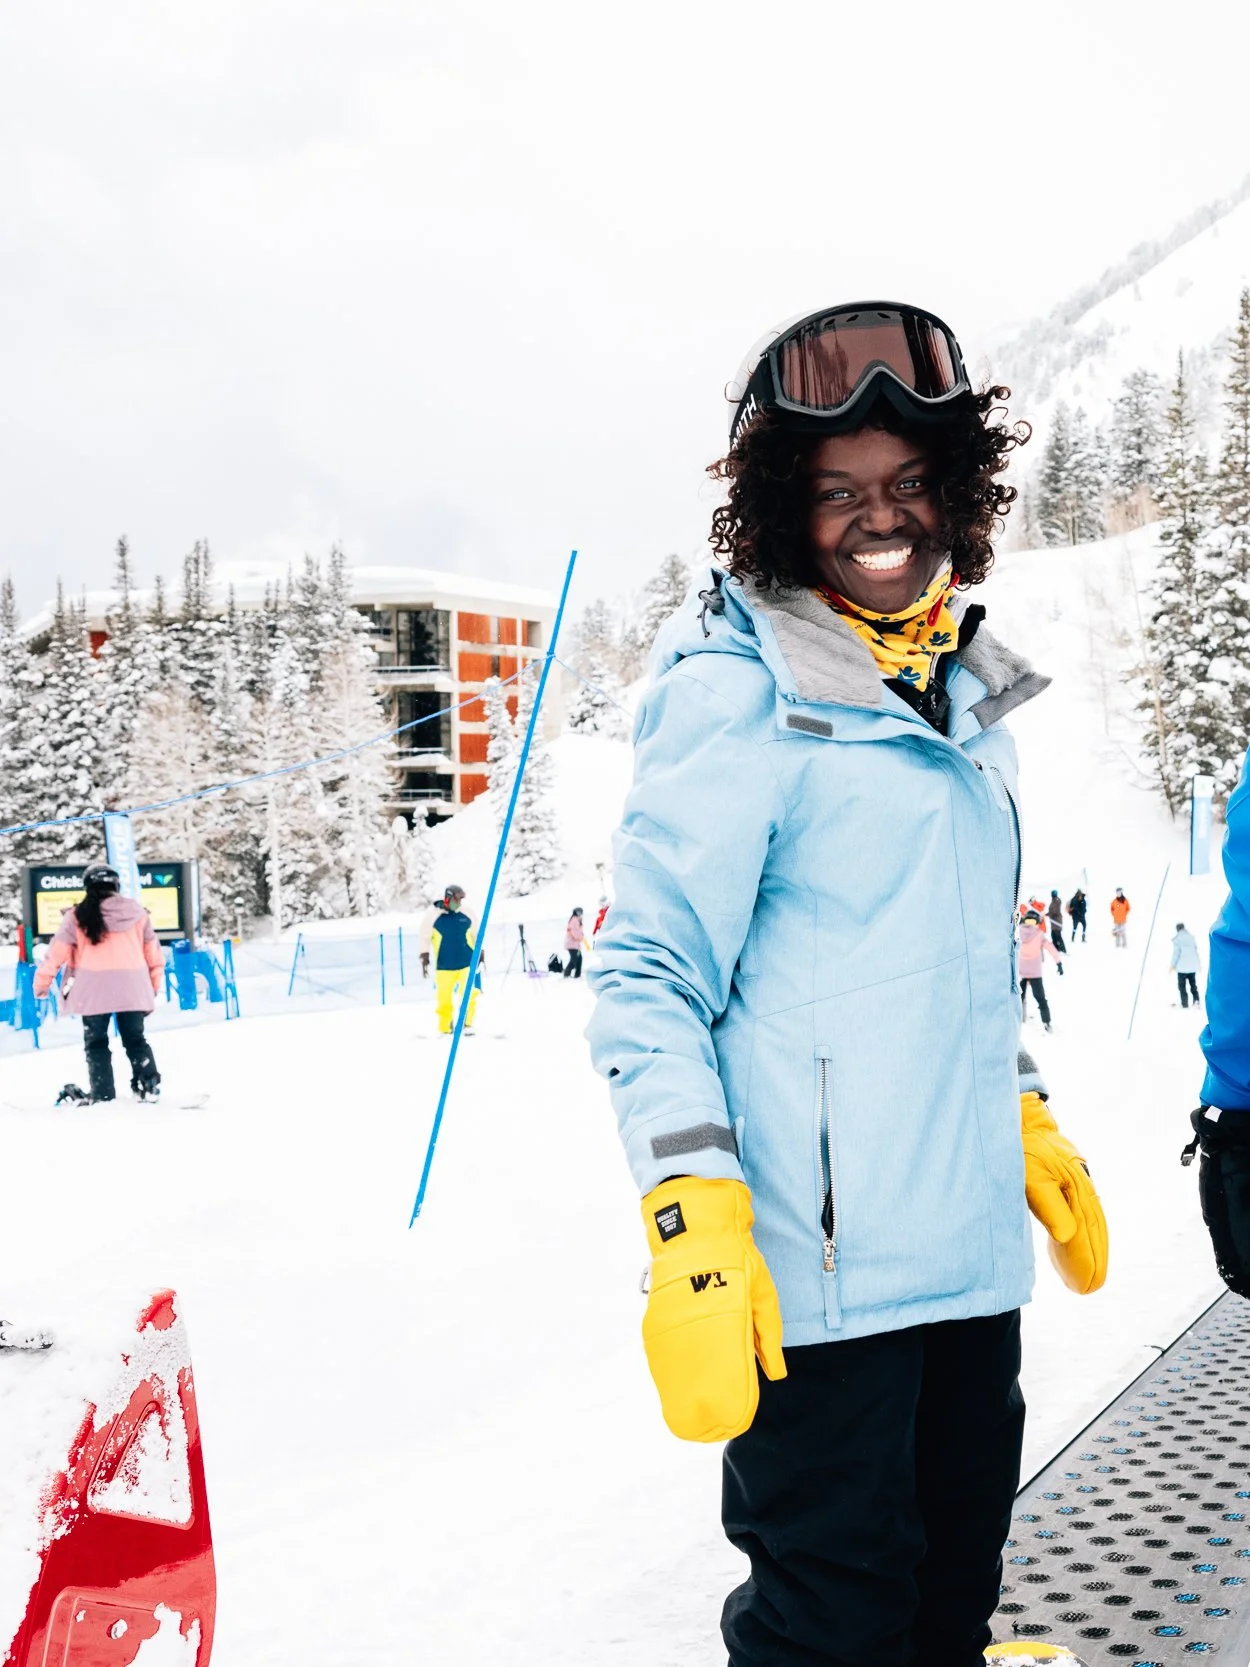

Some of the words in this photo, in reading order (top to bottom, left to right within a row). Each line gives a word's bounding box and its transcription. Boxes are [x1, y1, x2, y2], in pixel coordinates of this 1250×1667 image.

[731, 393, 757, 450] ITH
[41, 875, 84, 889] Chick
[656, 1208, 678, 1223] QUALITY
[661, 1216, 677, 1228] SINCE
